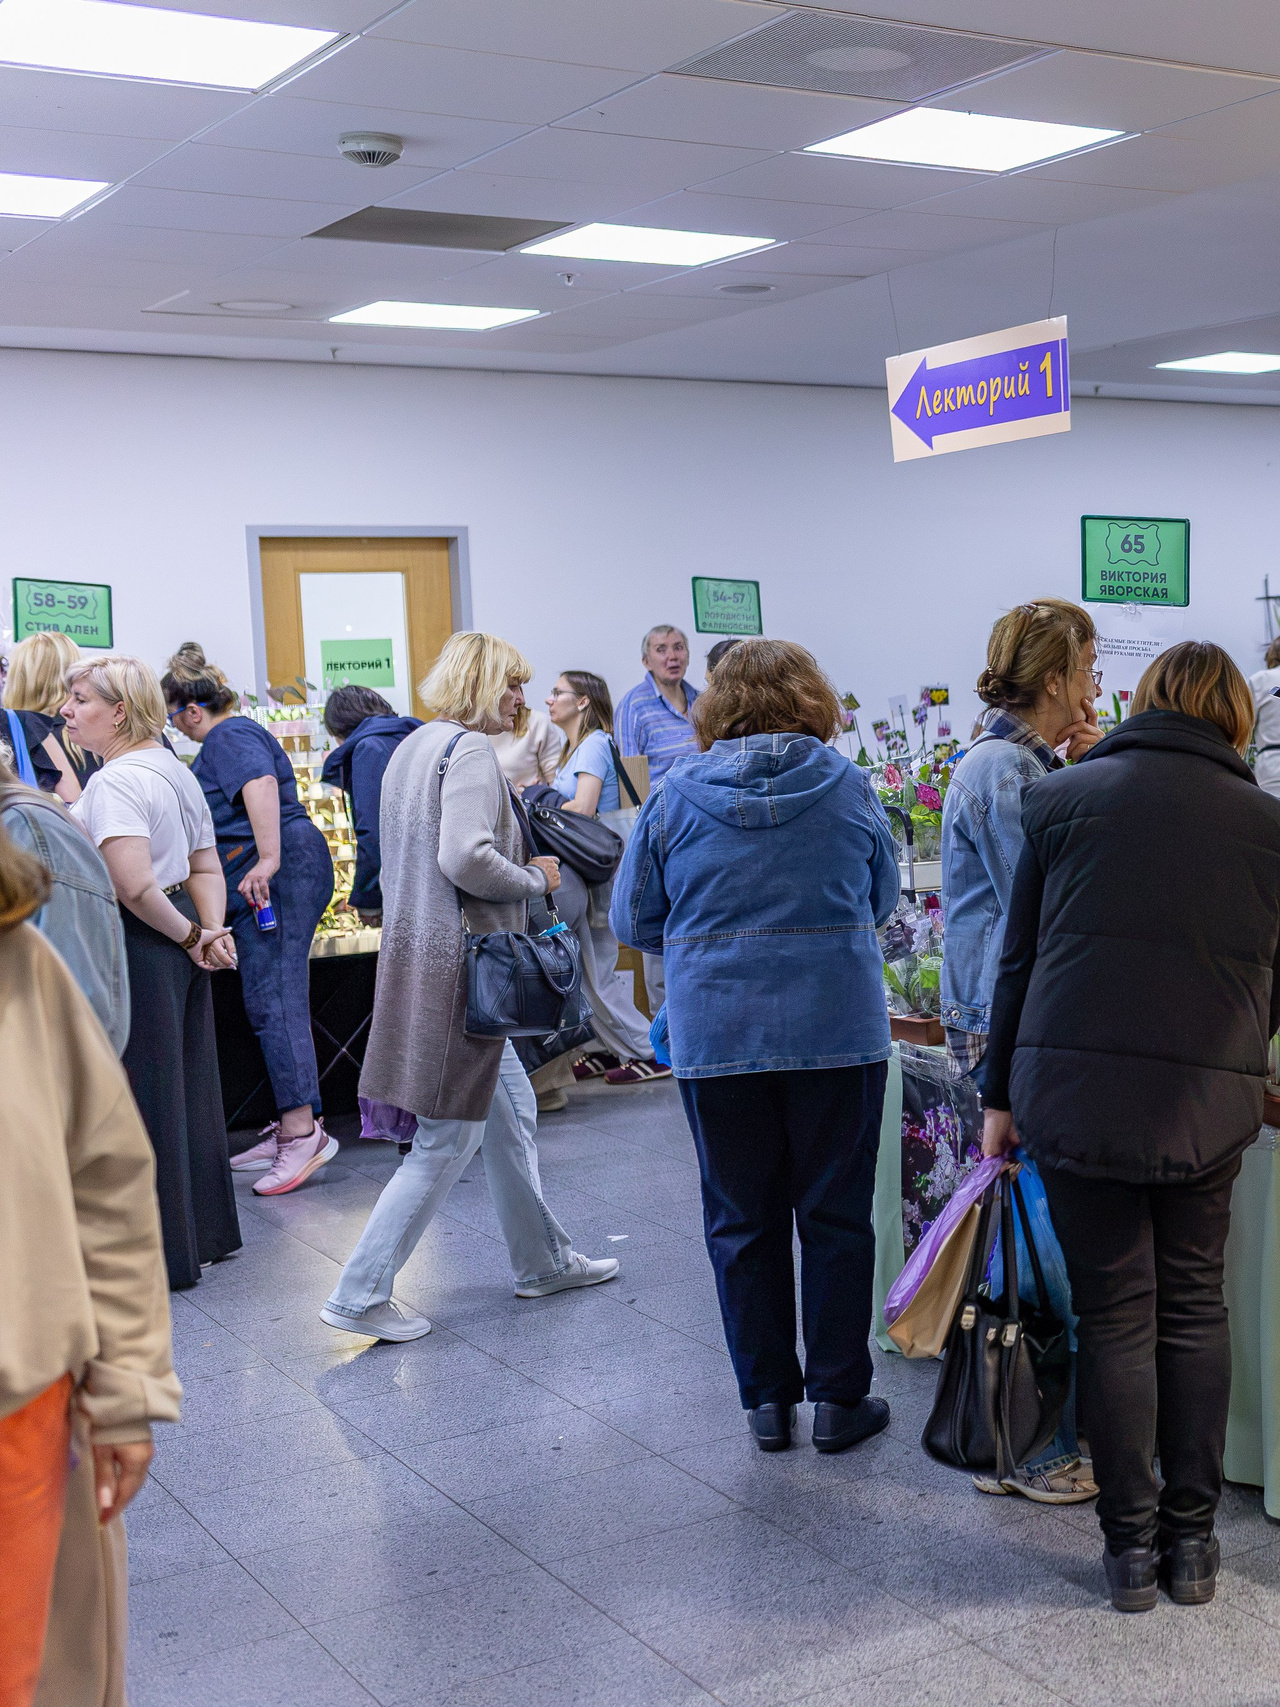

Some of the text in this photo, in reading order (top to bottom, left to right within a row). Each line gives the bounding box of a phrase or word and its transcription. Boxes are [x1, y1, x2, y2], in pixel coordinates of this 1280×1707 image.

[916, 351, 1053, 420] Лекторий 1
[1121, 534, 1145, 554] 65
[1100, 570, 1167, 584] ВИКТОРИЯ
[712, 590, 745, 604] 54-57
[1099, 585, 1168, 599] ЯВОРСКАЯ
[33, 592, 88, 609] 58-59
[25, 621, 99, 635] СТИВ АЛЕН
[326, 657, 391, 671] ЛЕКТОРИЙ 1
